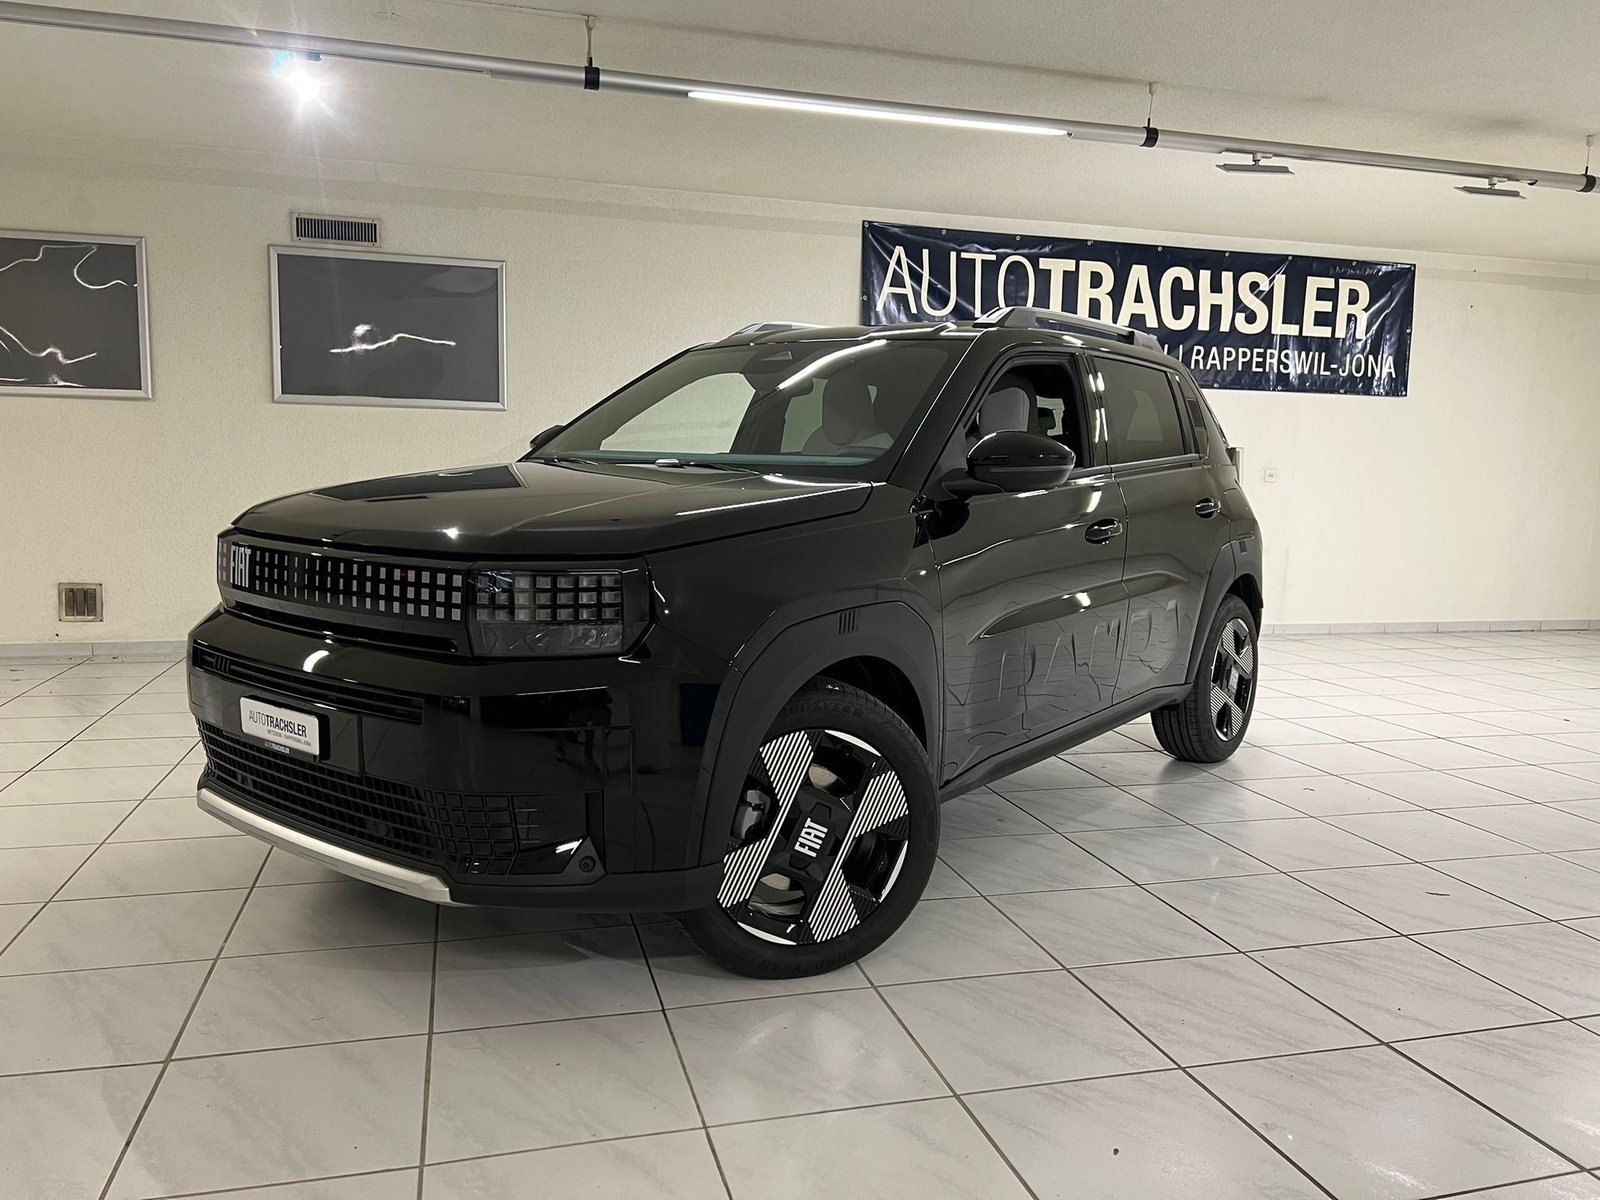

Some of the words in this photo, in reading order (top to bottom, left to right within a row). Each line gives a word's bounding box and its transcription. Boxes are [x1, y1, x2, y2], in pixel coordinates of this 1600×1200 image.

[875, 244, 1371, 340] AUTOTRACHSLER
[1190, 345, 1397, 379] RAPPERSWIL-JONA
[230, 544, 252, 588] FIAT
[248, 709, 308, 738] AUTOTRACHSLER
[794, 817, 829, 858] FIAT
